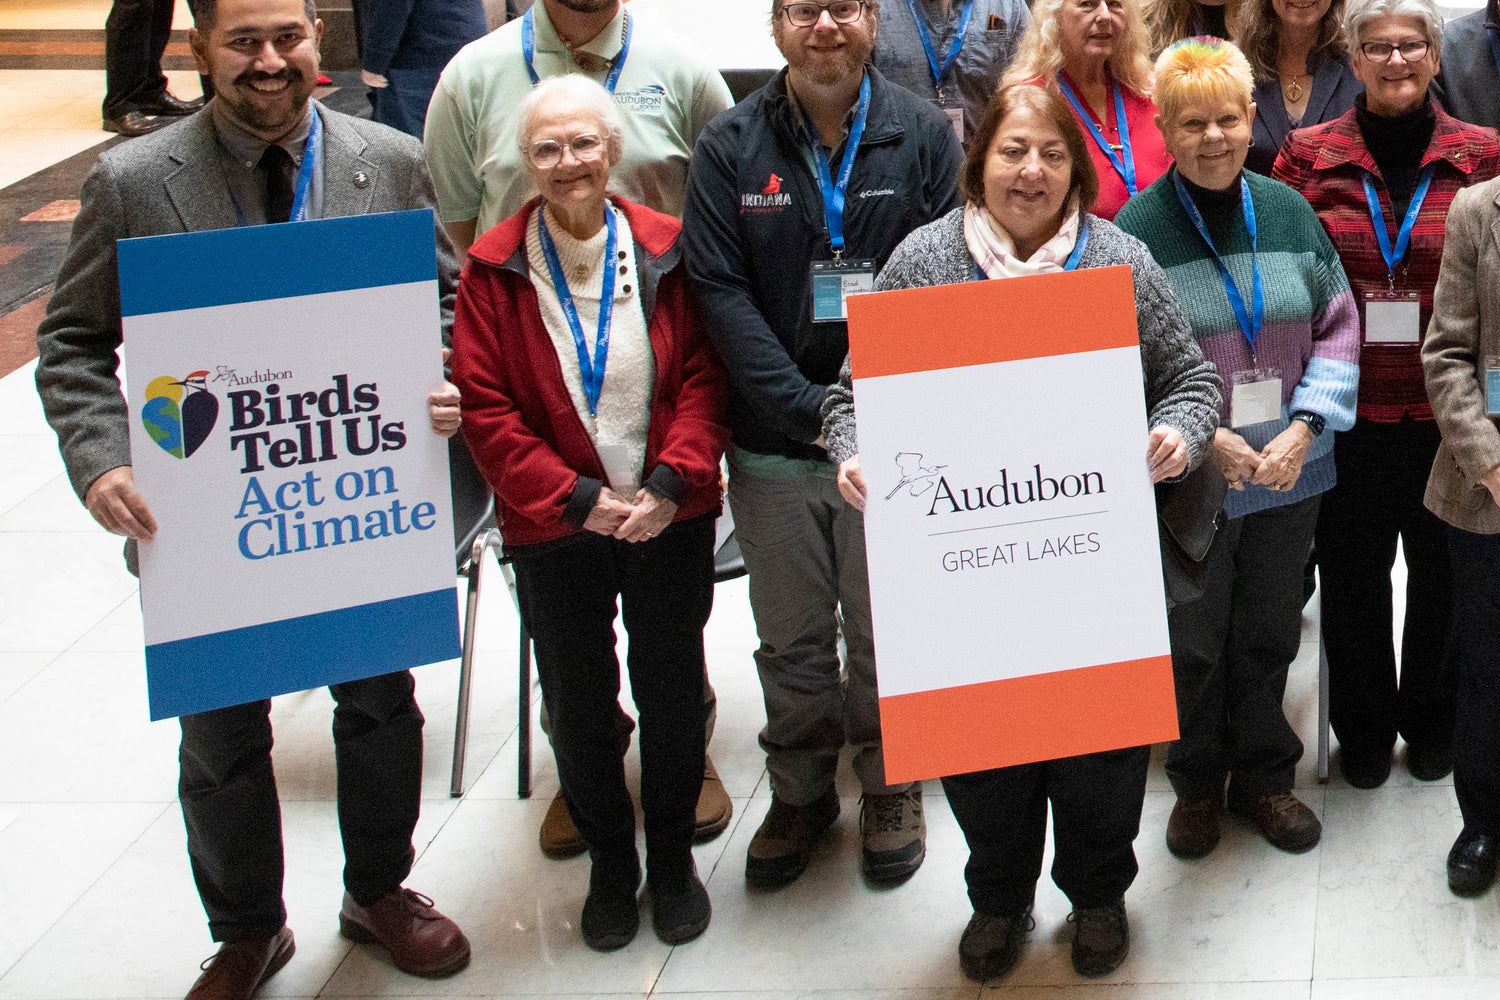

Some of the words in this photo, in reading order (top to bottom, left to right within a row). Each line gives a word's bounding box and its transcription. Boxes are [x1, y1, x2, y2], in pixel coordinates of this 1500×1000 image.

[741, 193, 792, 206] INDIANA
[866, 188, 894, 196] Columbia
[227, 374, 380, 431] Birds
[228, 368, 293, 386] Audubon
[230, 419, 337, 474] Tell
[341, 414, 407, 457] Us
[234, 470, 325, 519] Act
[334, 465, 399, 500] on
[926, 463, 1106, 516] Audubon
[237, 499, 437, 561] Climate
[942, 543, 1018, 573] GREAT
[1026, 532, 1101, 562] LAKES
